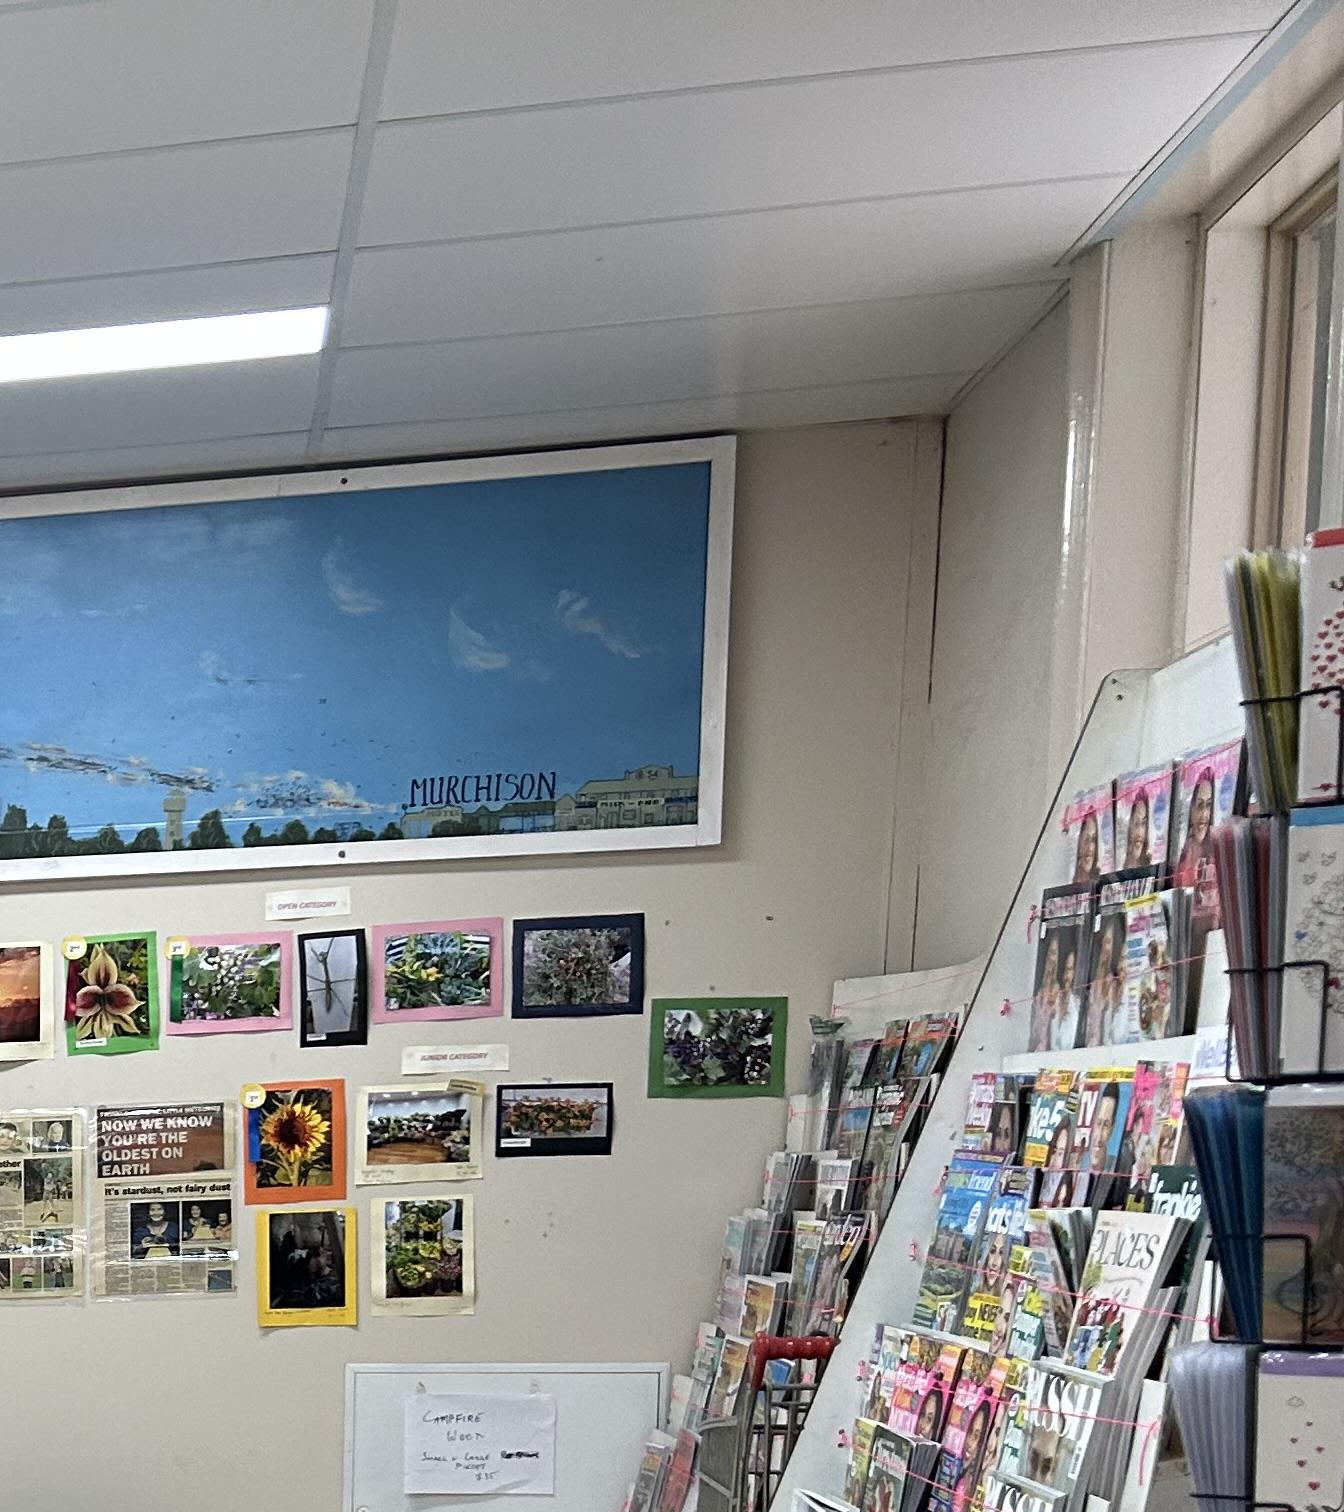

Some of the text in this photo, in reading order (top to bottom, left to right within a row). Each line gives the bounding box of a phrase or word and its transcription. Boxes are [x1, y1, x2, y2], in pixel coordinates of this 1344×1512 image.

[409, 771, 556, 807] MURCHISON
[299, 901, 337, 909] CATEGORY
[448, 1052, 488, 1060] CATEGORY
[101, 1115, 212, 1132] NOW WE KNOW
[102, 1132, 188, 1147] YOU'RE THE
[102, 1147, 183, 1162] OLDEST ON
[102, 1163, 150, 1177] EARTH
[105, 1184, 230, 1196] It's stardust, not fairy dust
[423, 1410, 486, 1423] CAMPFIRE
